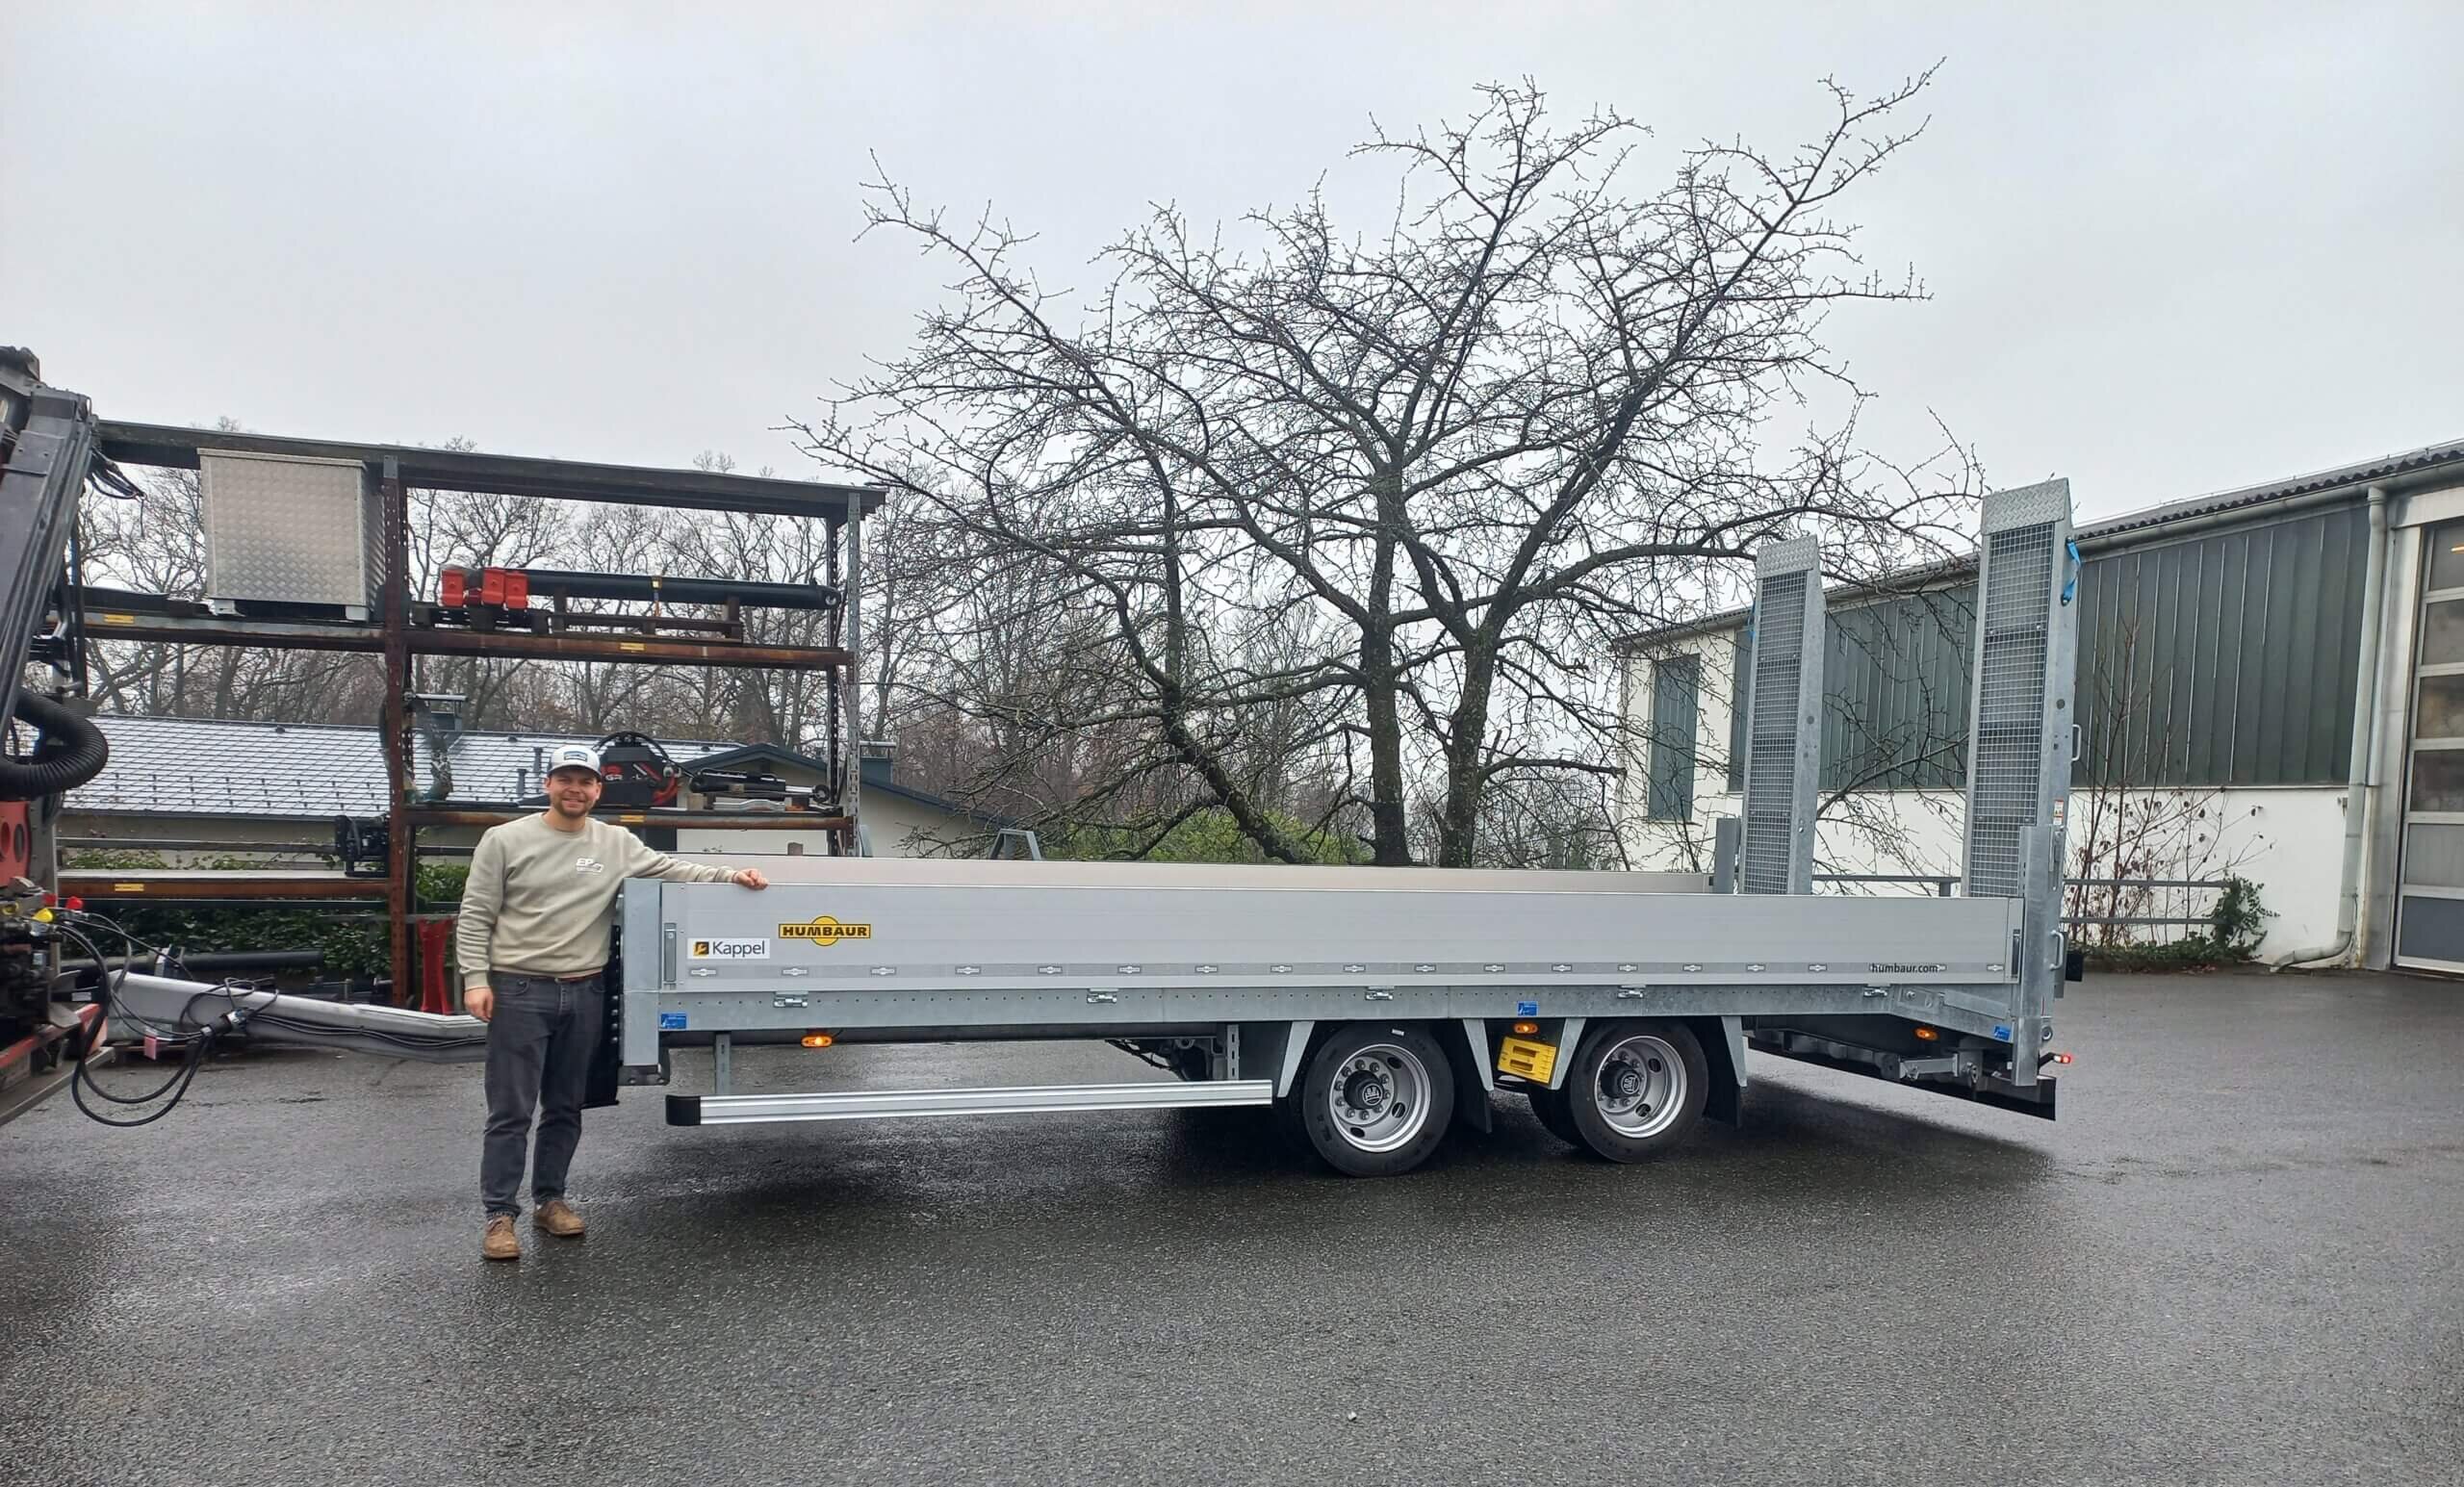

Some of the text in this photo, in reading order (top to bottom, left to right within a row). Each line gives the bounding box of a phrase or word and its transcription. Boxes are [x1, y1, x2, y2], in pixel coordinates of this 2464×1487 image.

[783, 926, 868, 936] HUMBAUR
[712, 940, 766, 958] Kappel
[1871, 962, 1938, 973] humbaur.com
